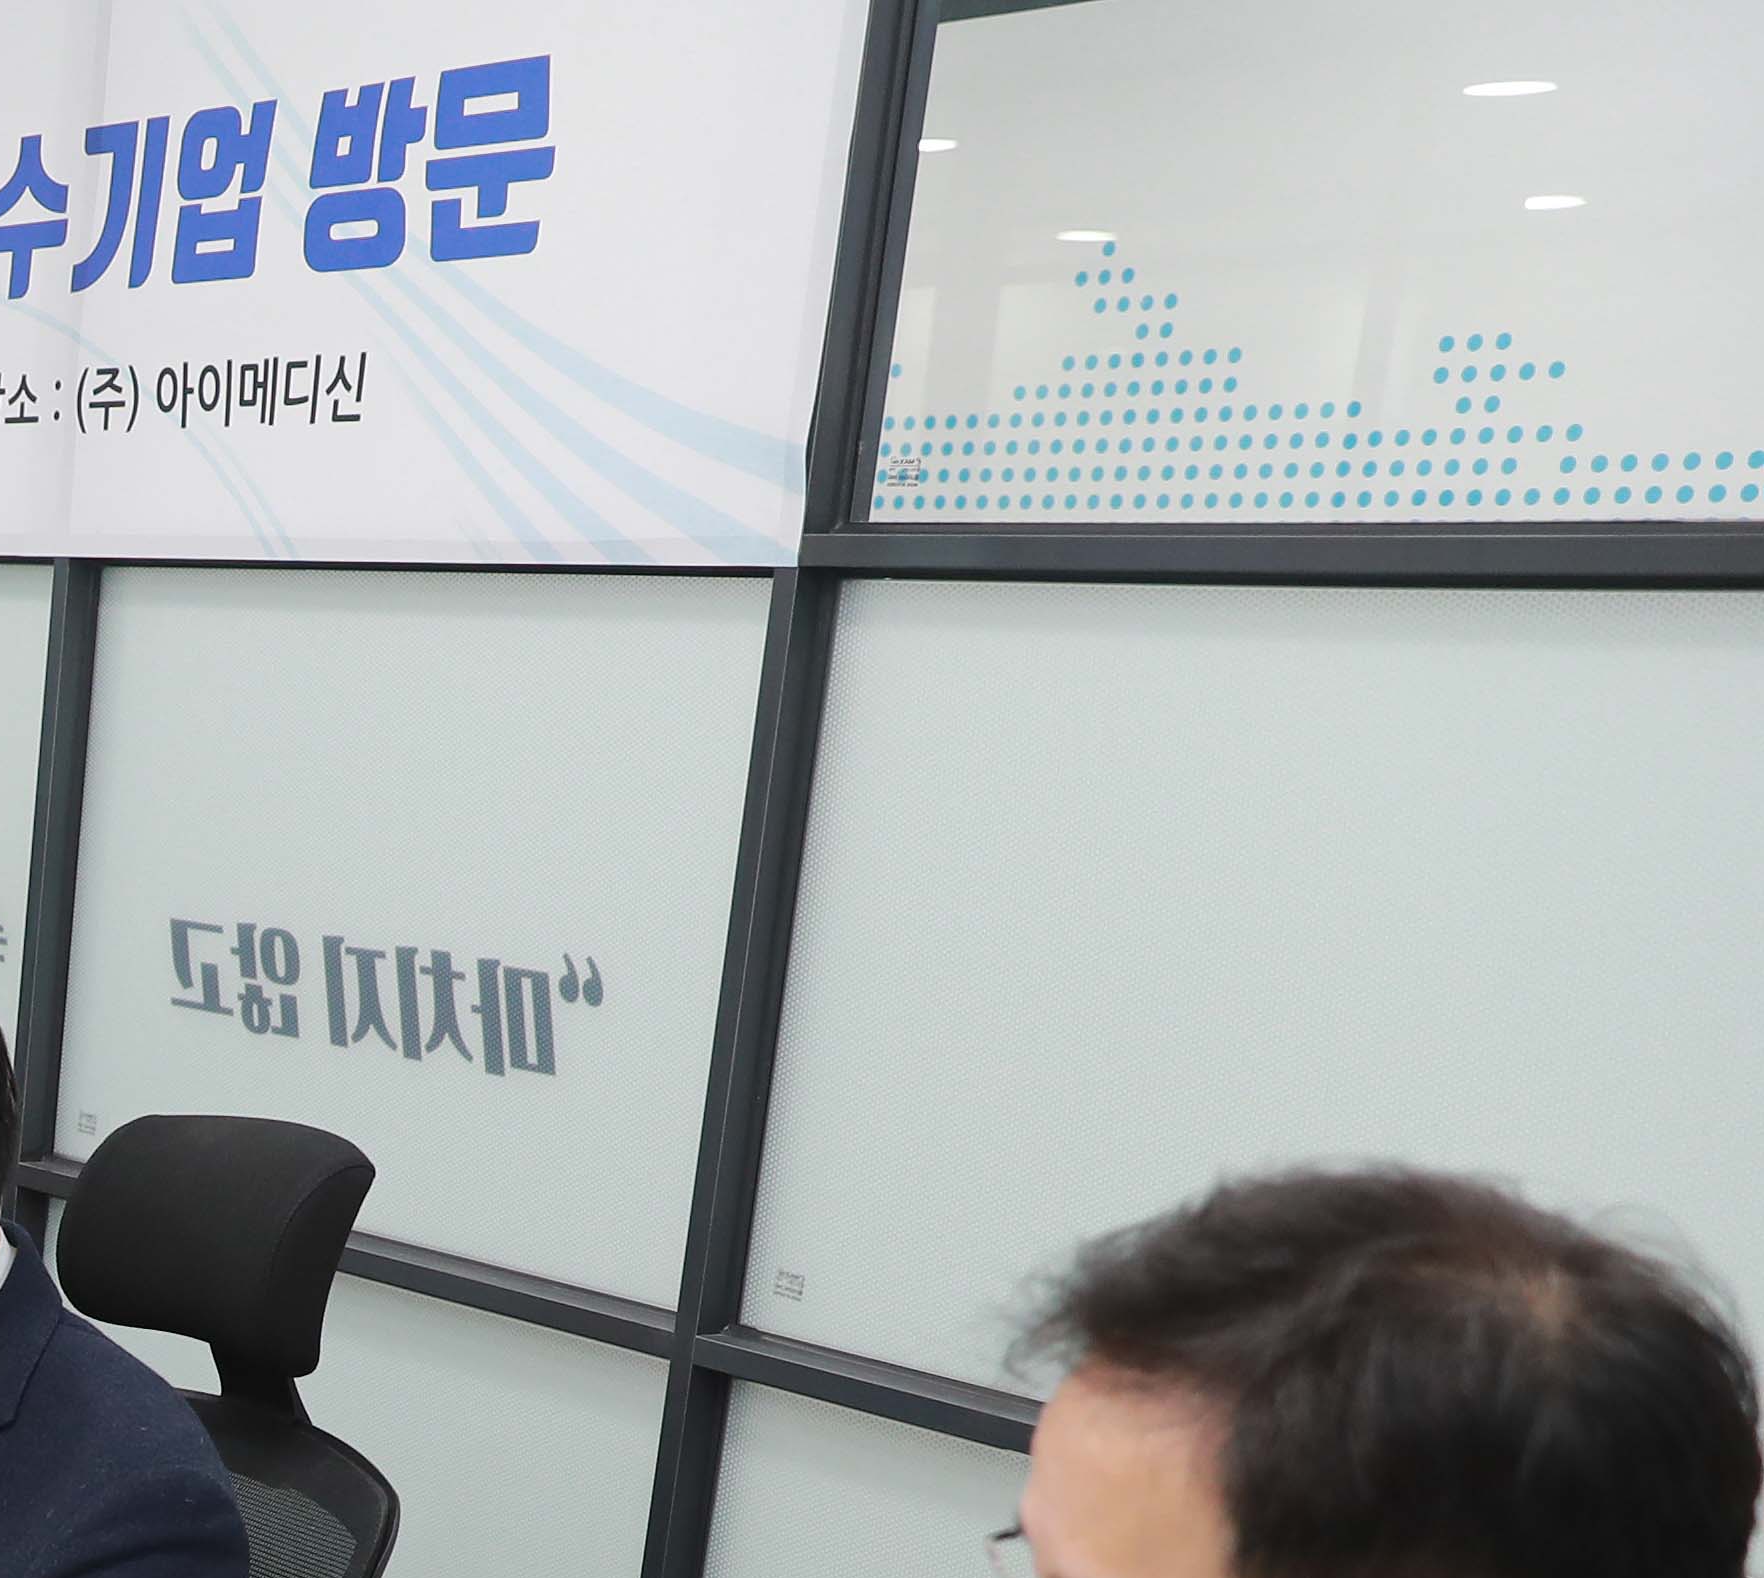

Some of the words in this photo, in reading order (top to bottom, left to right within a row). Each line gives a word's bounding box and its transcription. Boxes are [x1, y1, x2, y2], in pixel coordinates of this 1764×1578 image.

[303, 54, 557, 274] 방문
[76, 364, 140, 434] (주)
[156, 350, 369, 430] 아이메디신
